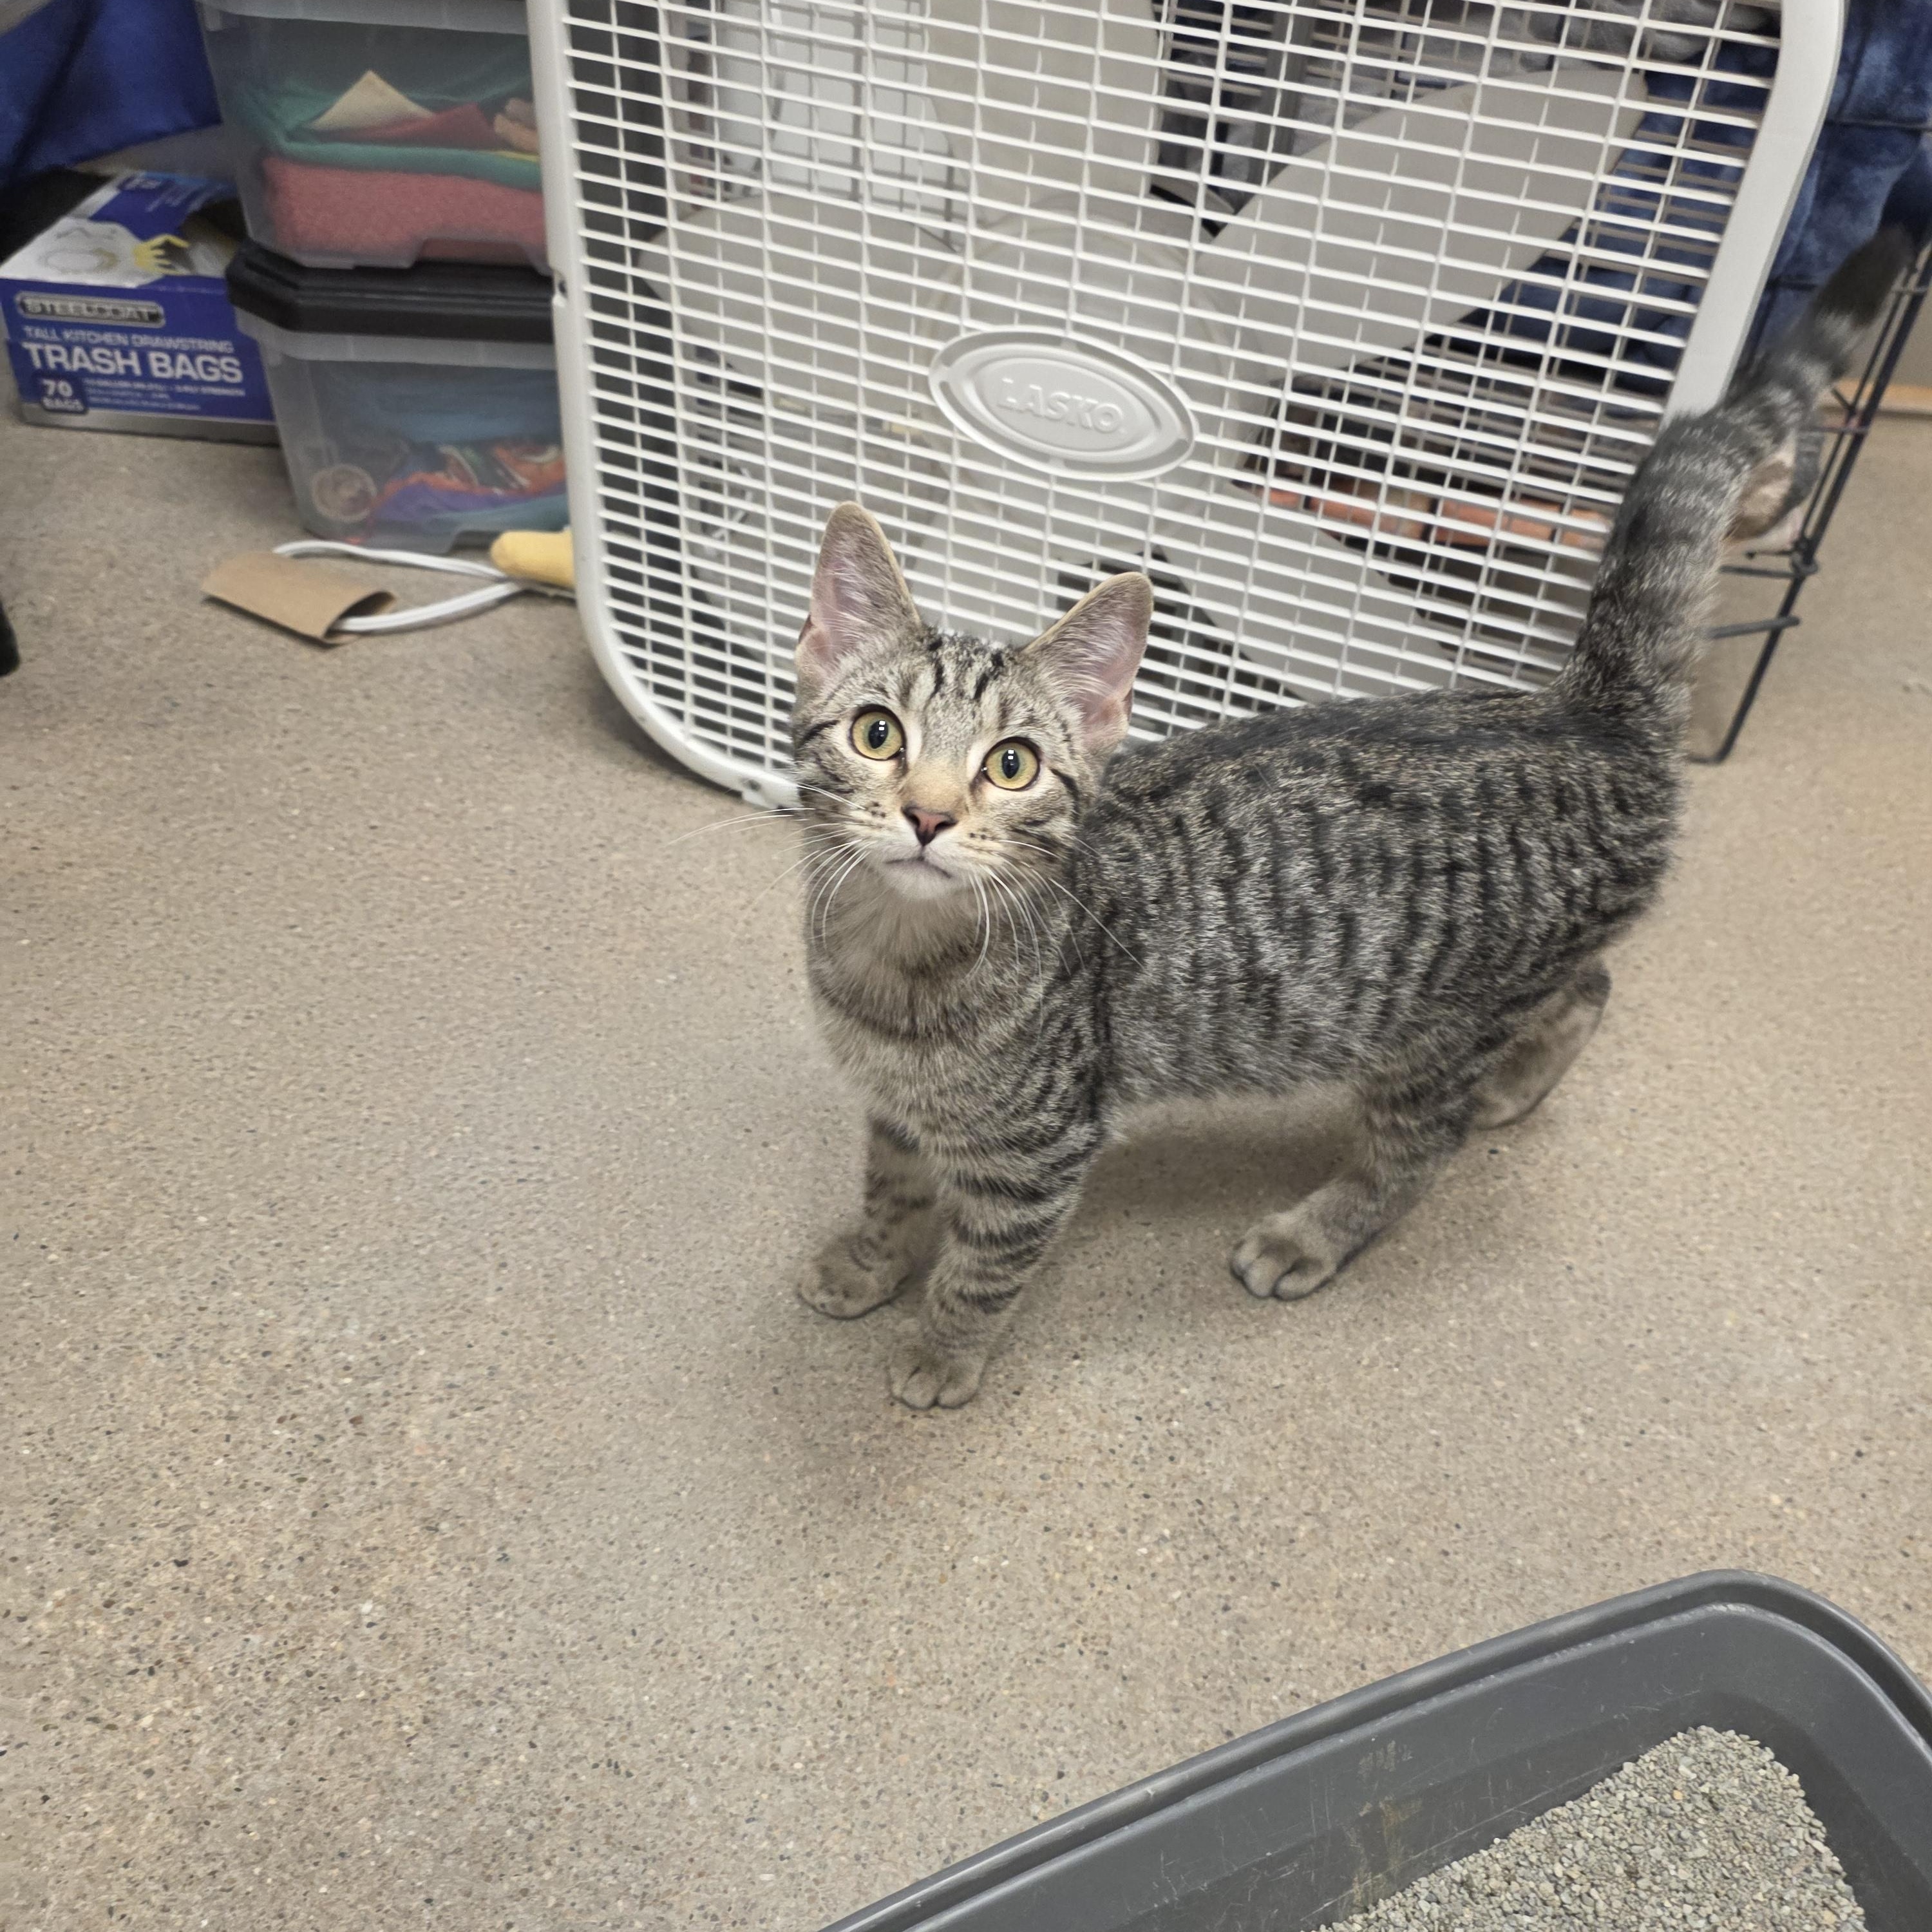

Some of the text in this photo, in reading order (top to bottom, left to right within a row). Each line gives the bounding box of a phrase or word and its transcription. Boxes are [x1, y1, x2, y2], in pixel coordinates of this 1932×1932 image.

[23, 325, 234, 354] TALL KITCHEN DRAWSTRING
[22, 342, 243, 383] TRASH BAGS
[42, 379, 73, 397] 70
[43, 397, 85, 412] BAGS
[998, 377, 1123, 433] LASKO
